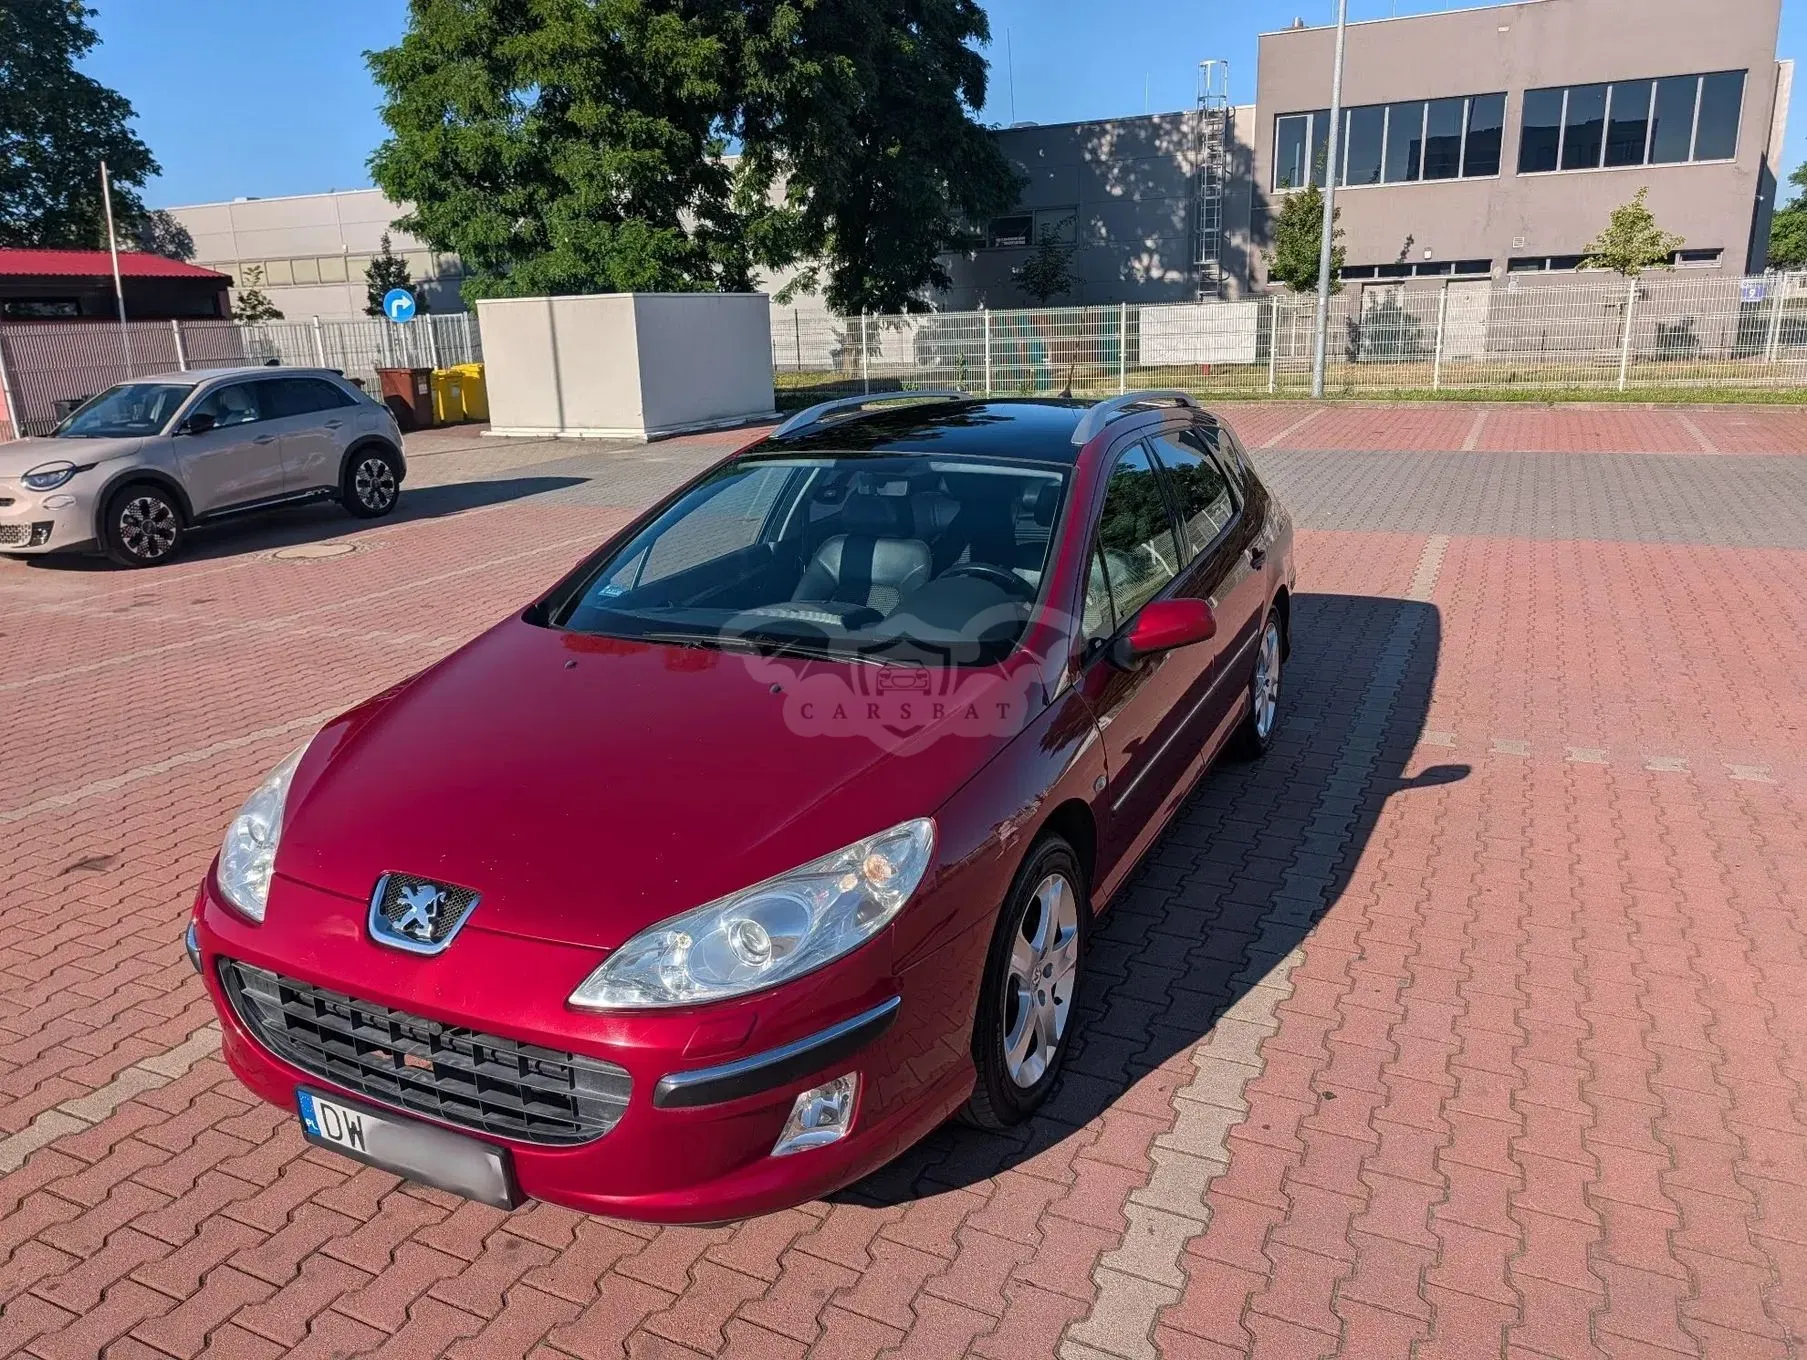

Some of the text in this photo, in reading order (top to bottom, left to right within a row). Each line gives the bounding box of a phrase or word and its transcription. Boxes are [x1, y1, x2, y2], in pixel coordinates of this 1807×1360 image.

[1749, 289, 1756, 298] 9
[305, 1118, 319, 1131] PL
[320, 1103, 366, 1152] DW
